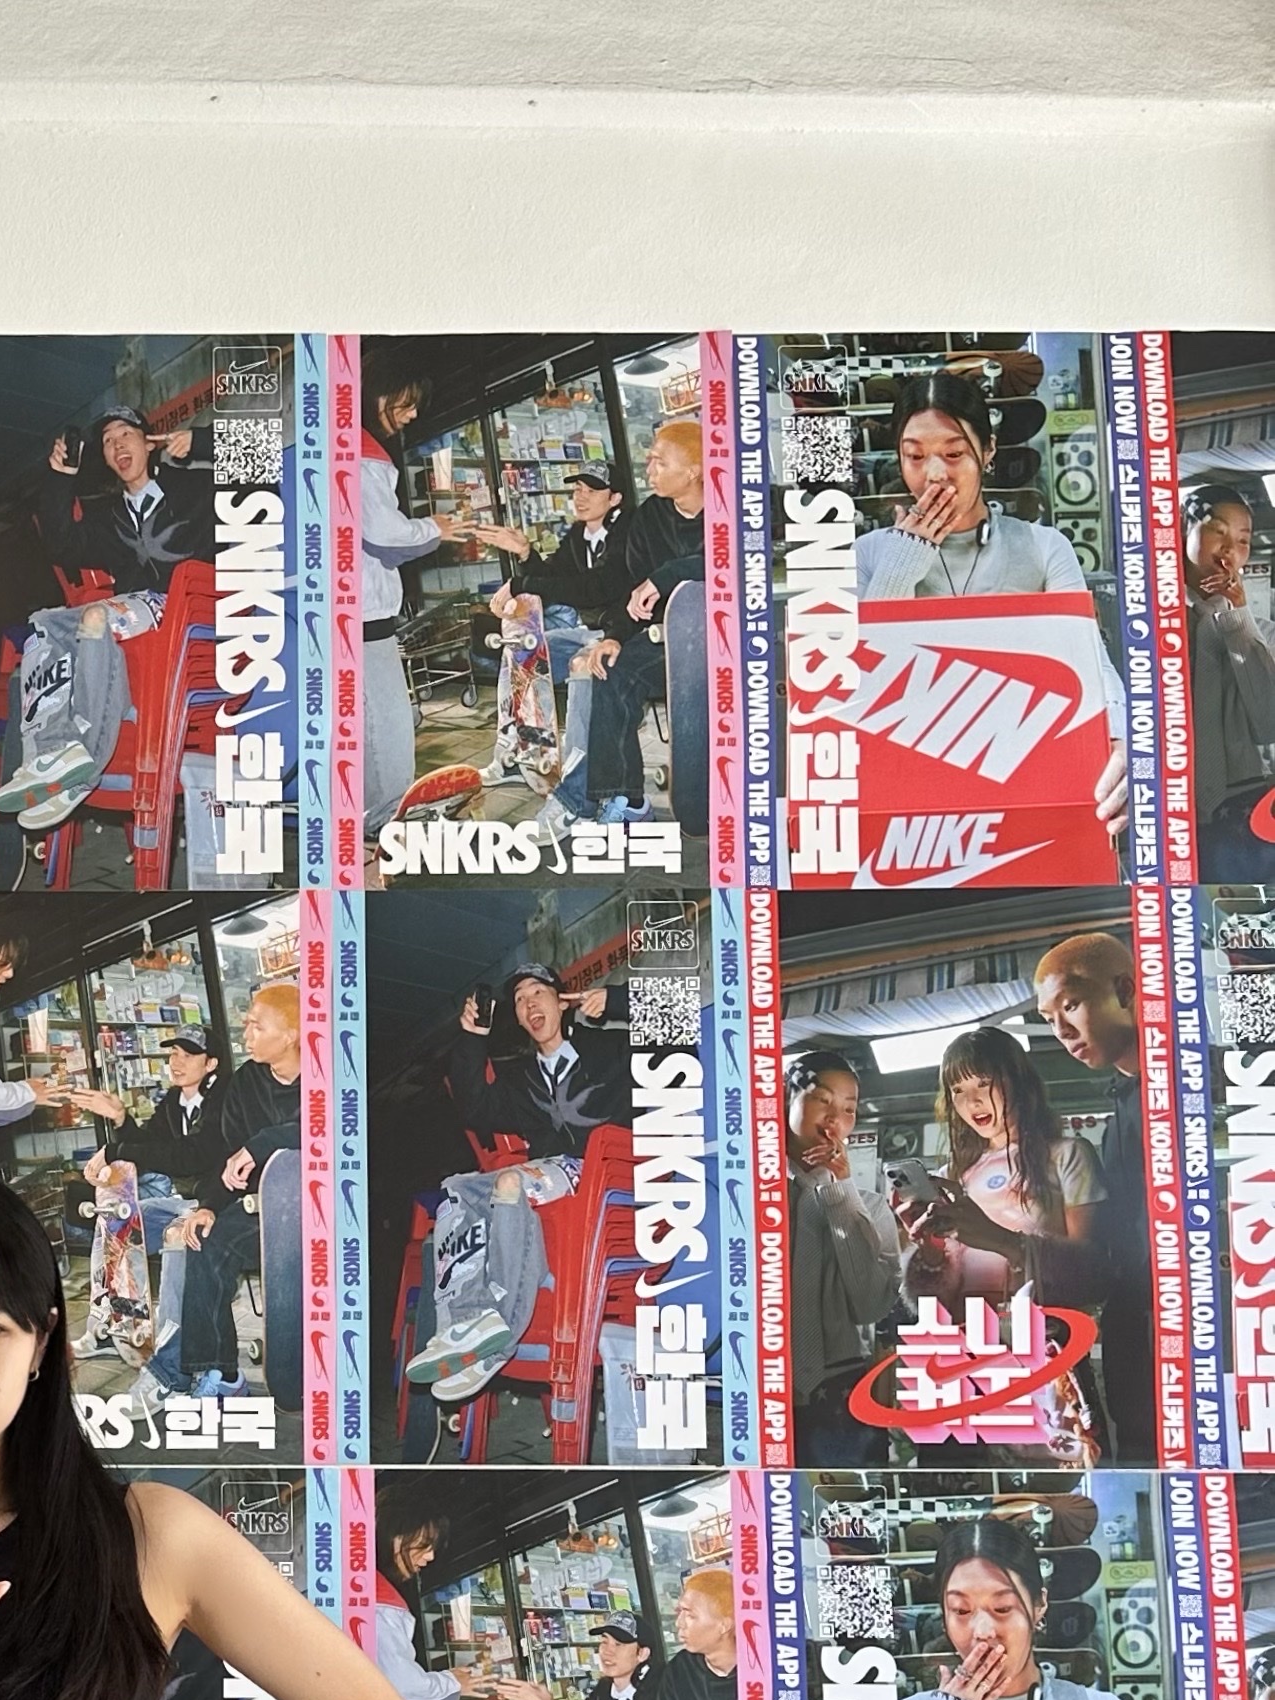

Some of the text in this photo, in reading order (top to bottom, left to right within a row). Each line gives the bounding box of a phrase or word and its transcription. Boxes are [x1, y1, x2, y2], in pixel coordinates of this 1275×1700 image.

[303, 383, 319, 427] SNKRS
[305, 524, 321, 569] SNKRS
[1143, 334, 1189, 858] DOWNLOAD THE APP SNKRS DOWNLOAD THE APP
[214, 489, 289, 875] SNKRS 한국
[306, 668, 322, 715] SNKRS
[784, 488, 861, 876] SNKRS 한국
[307, 818, 323, 865] SNKRS
[379, 820, 681, 876] SNKRS 한국
[874, 813, 1004, 870] NIKE
[1137, 889, 1160, 937] JOIN
[721, 939, 739, 986] SNKRS
[1140, 944, 1164, 996] NOW
[725, 1087, 742, 1135] SNKRS
[750, 894, 786, 1441] DOWNLOAD THE APP SNKRS DOWNLOAD THE APP
[1150, 1118, 1173, 1186] KOREA
[631, 1053, 711, 1450] SNKRS 한국
[729, 1238, 746, 1287] SNKRS
[1155, 1221, 1179, 1269] JOIN
[1159, 1277, 1182, 1330] NOW
[164, 1396, 276, 1450] 한국
[731, 1392, 749, 1441] SNKRS
[741, 1525, 758, 1574] SNKRS
[770, 1475, 795, 1594] DOWNLOAD
[775, 1601, 797, 1638] THE
[777, 1644, 799, 1687] APP
